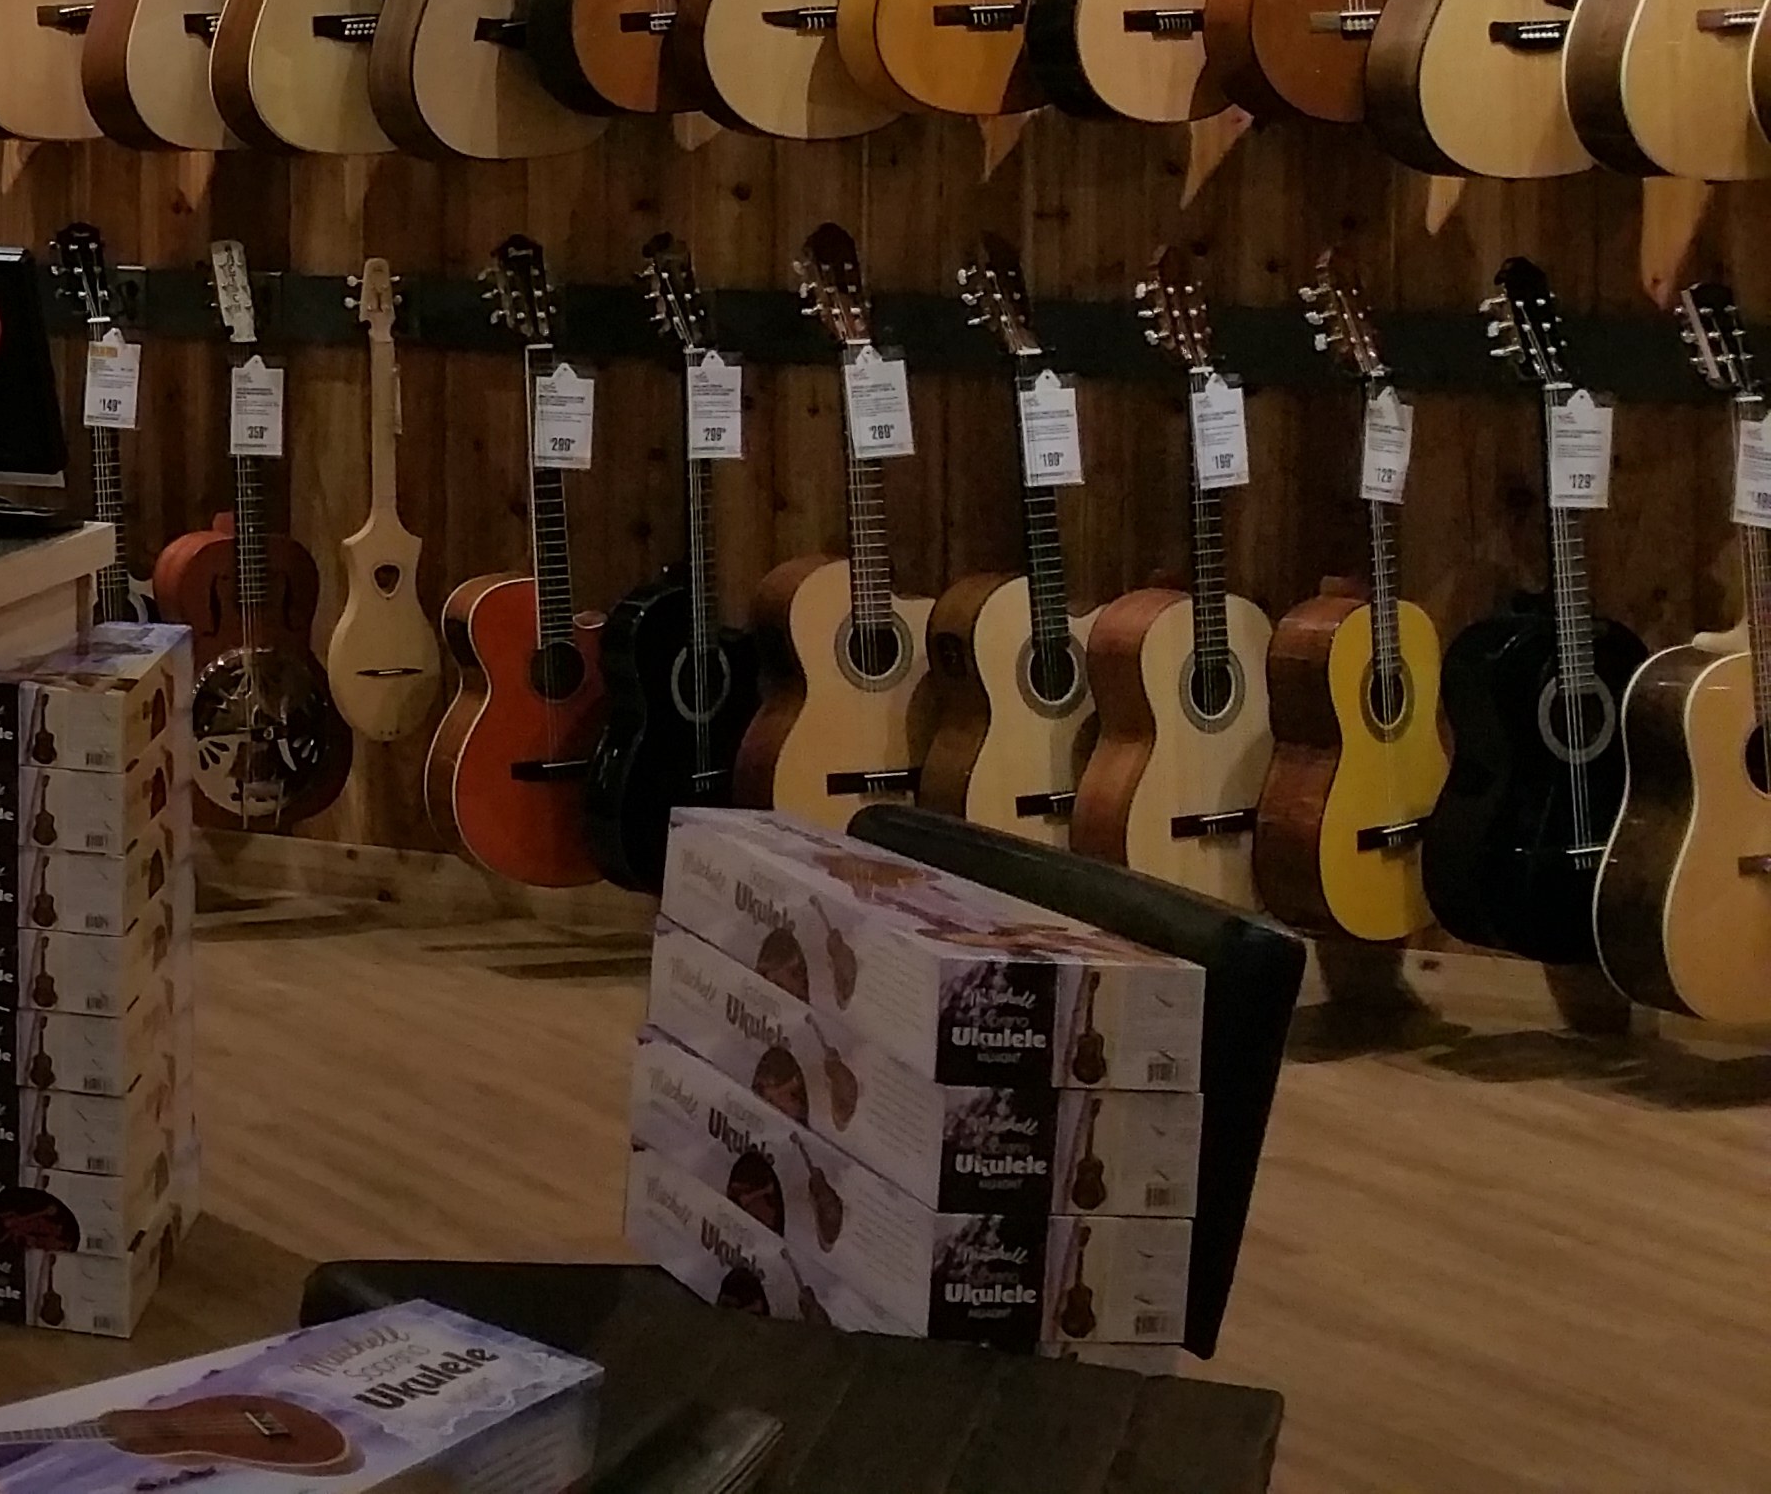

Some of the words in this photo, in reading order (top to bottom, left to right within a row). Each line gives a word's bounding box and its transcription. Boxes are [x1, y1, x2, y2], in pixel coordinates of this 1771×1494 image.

[952, 1026, 1047, 1049] Ukulele
[955, 1154, 1047, 1176] Ukulele
[944, 1283, 1037, 1306] Ukulele
[353, 1346, 499, 1410] Ukulele
